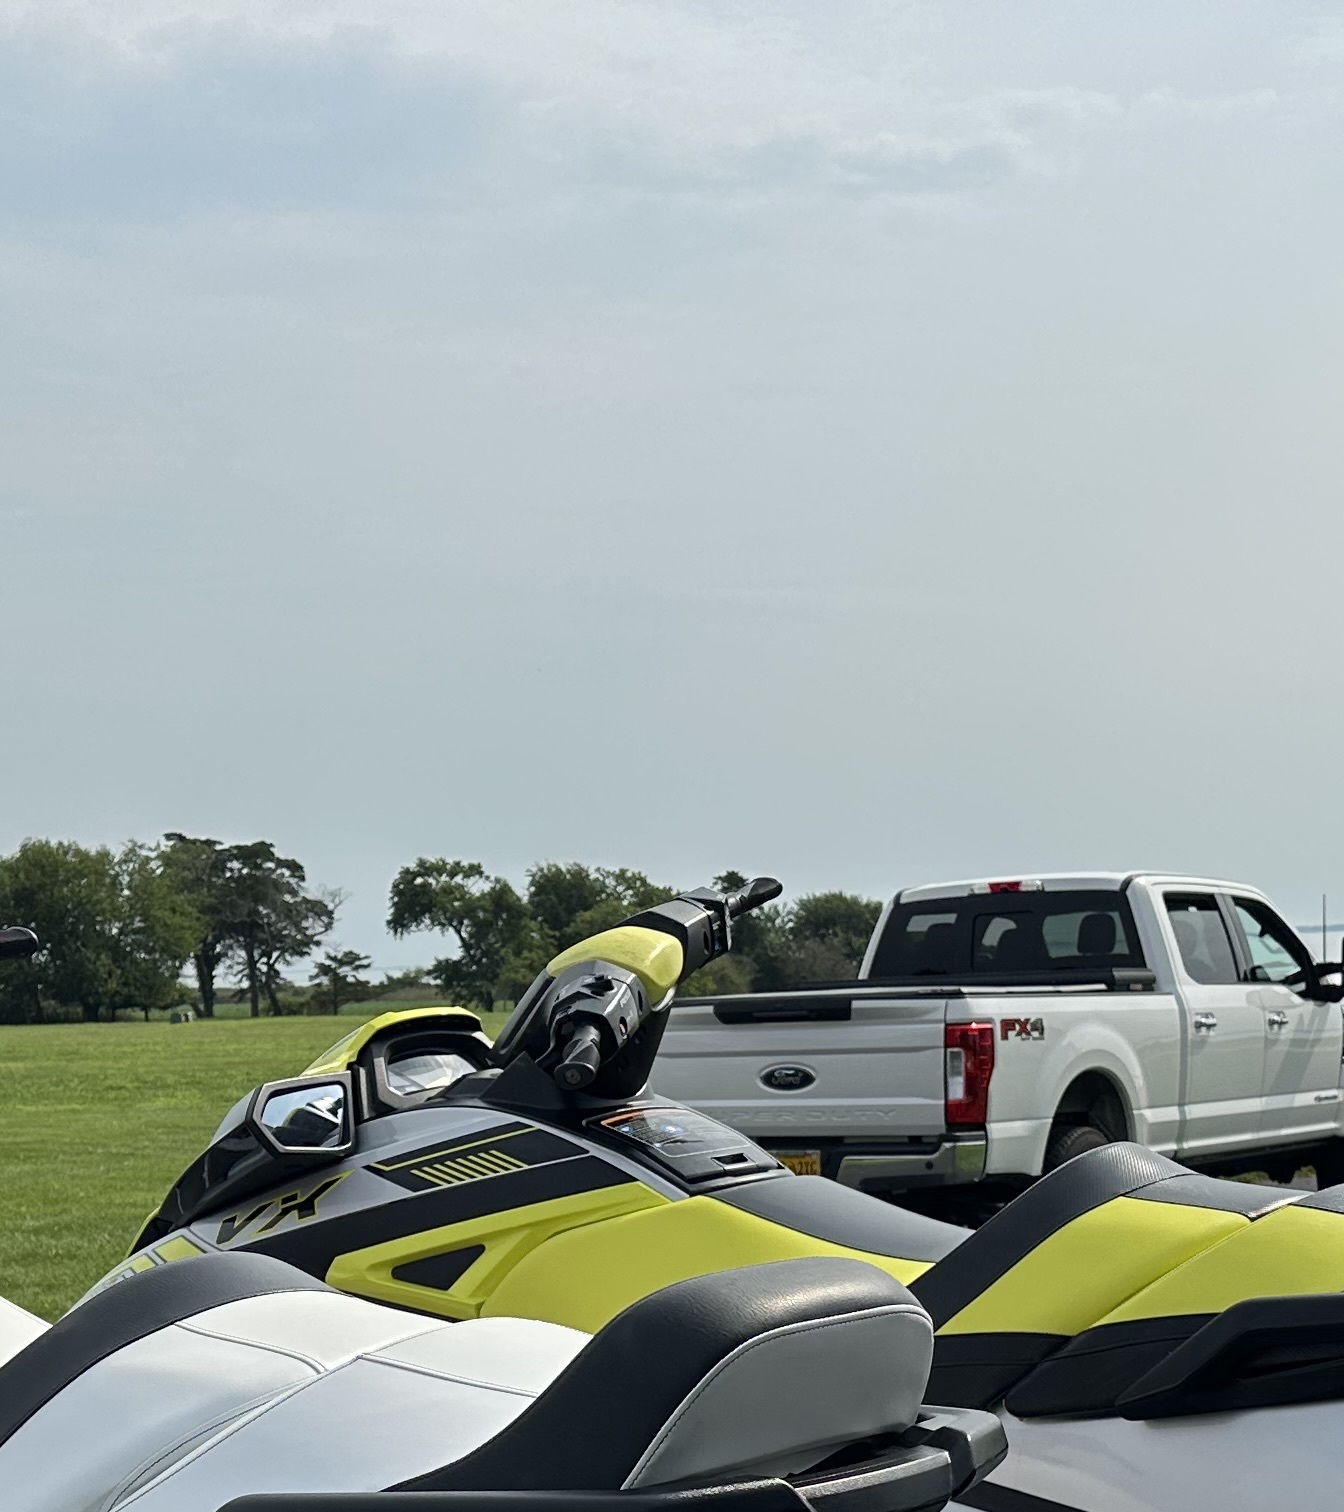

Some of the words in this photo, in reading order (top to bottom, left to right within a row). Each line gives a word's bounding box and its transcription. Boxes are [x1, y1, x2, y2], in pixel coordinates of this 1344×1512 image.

[1000, 1018, 1044, 1040] FX4
[807, 1109, 896, 1122] DUTY
[216, 1169, 355, 1245] VX
